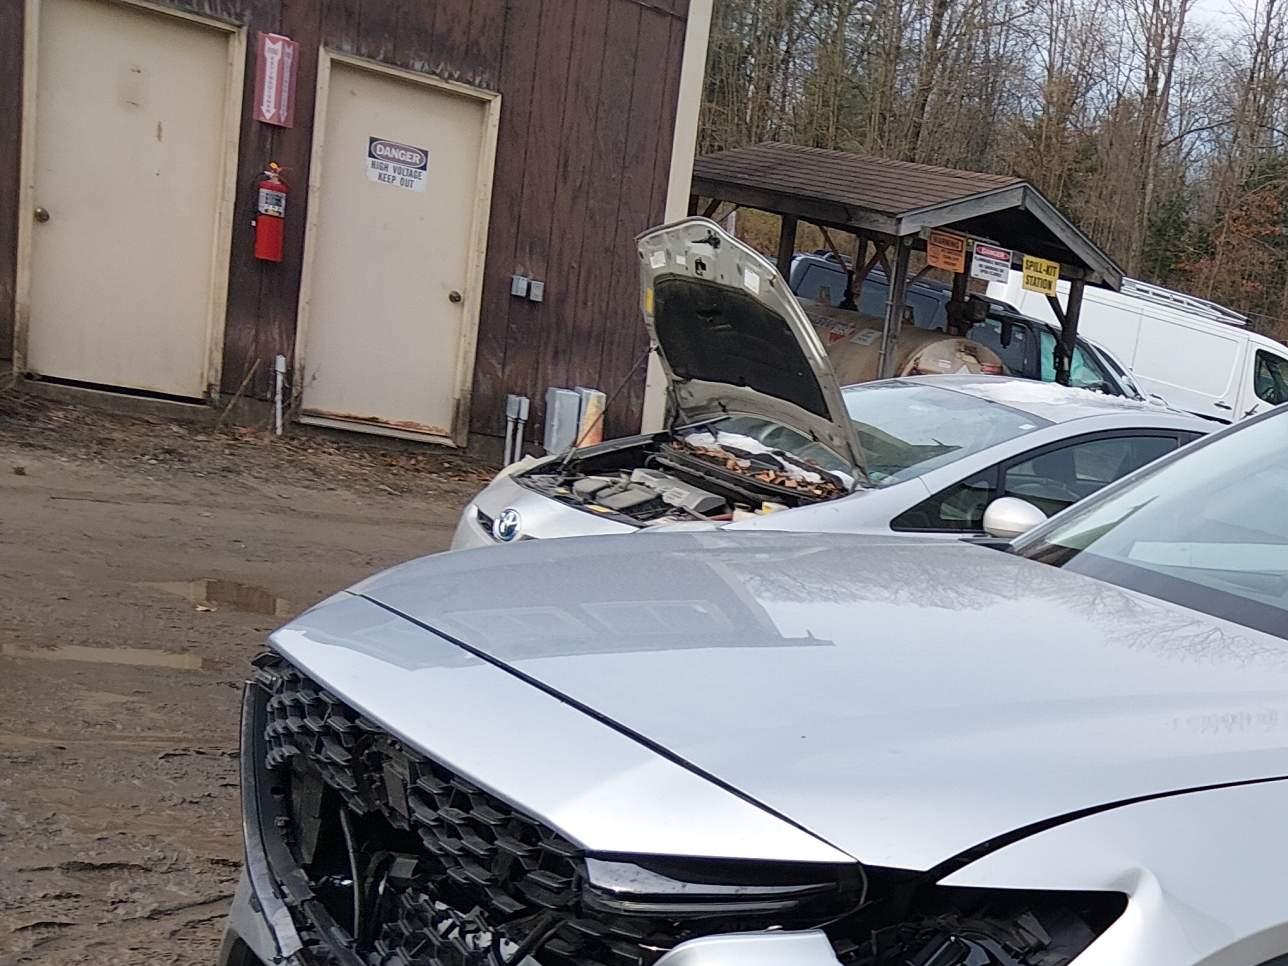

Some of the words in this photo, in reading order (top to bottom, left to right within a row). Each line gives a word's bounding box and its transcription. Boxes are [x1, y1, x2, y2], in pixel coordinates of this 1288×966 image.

[376, 144, 421, 165] DANGER
[371, 160, 389, 172] HIGH
[393, 165, 423, 180] VOLTAGE
[378, 172, 396, 184] KEEP
[400, 177, 415, 188] OUT
[1025, 259, 1057, 277] SPILL-KIT
[1025, 274, 1052, 290] STATION
